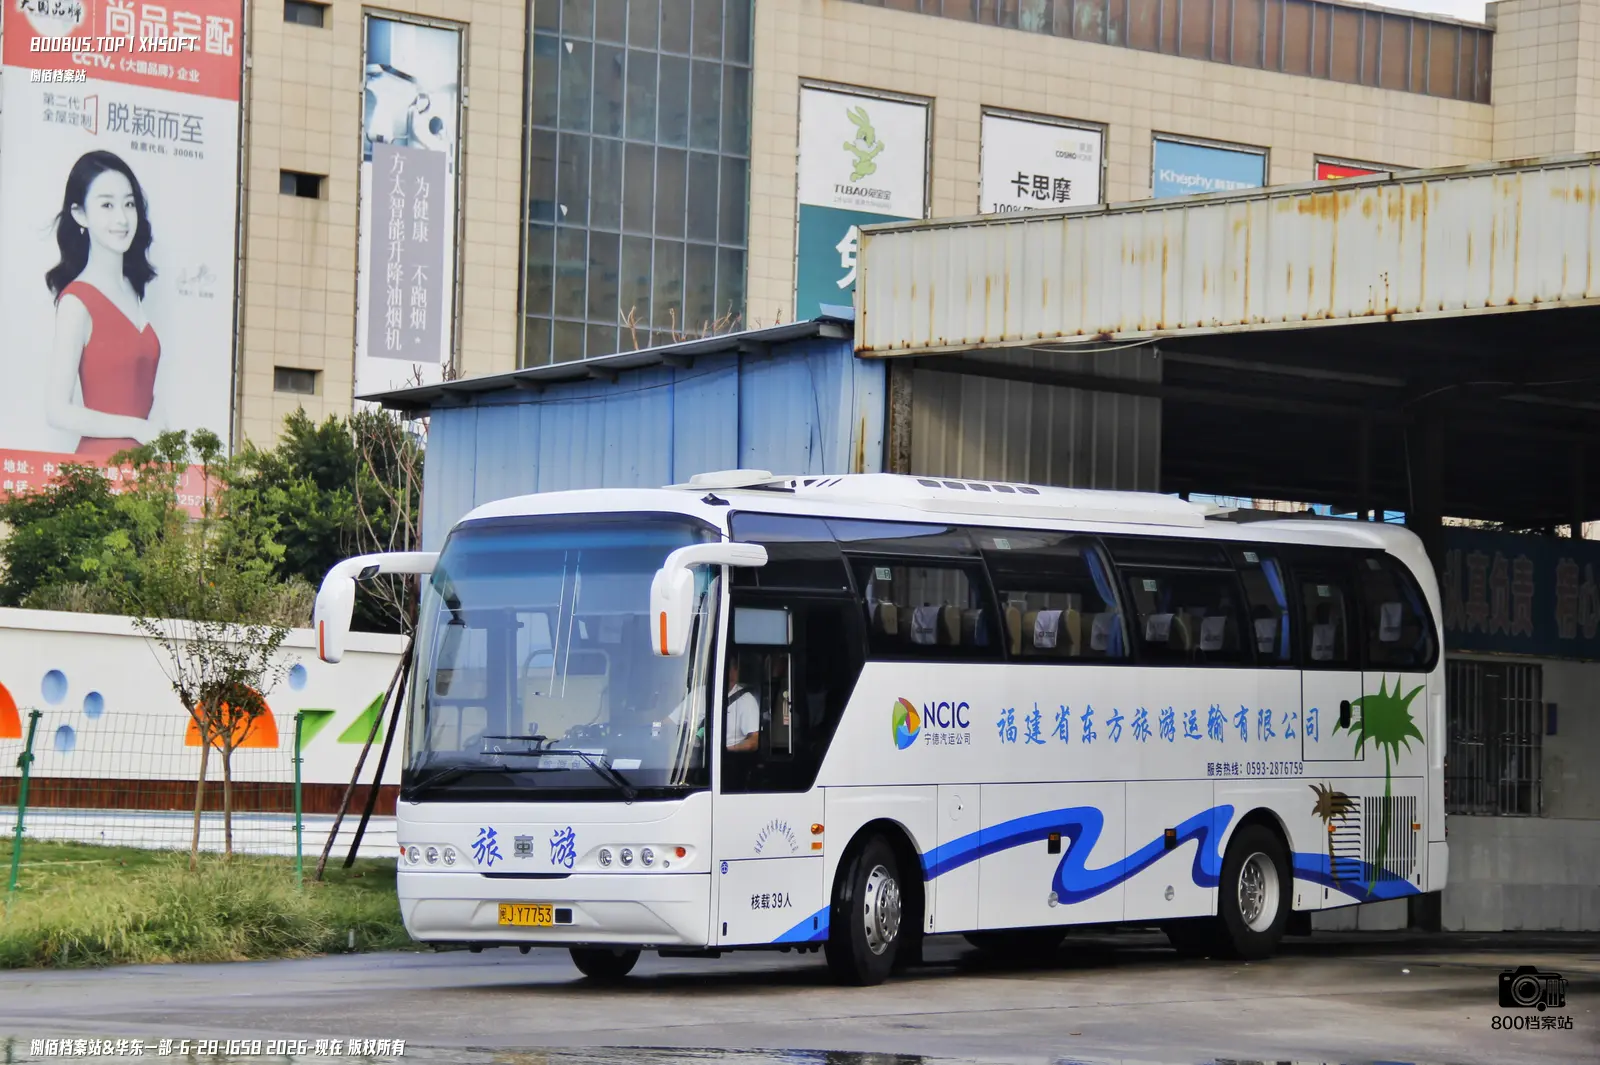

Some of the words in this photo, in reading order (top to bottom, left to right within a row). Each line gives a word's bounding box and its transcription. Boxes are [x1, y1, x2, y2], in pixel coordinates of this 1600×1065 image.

[105, 0, 234, 56] 尚品宅配
[43, 92, 80, 110] 第二代
[43, 109, 92, 129] 全屋定制
[107, 102, 204, 144] 脱颖而至
[1011, 171, 1072, 203] 卡思摩
[412, 176, 430, 243] 为健康
[385, 153, 407, 351] 方太智能升降油烟机
[923, 702, 970, 729] NCIC
[996, 702, 1319, 745] 福建省东方旅游运输有限公司
[924, 733, 971, 746] 宁德汽运公司
[751, 893, 792, 910] 核载39人
